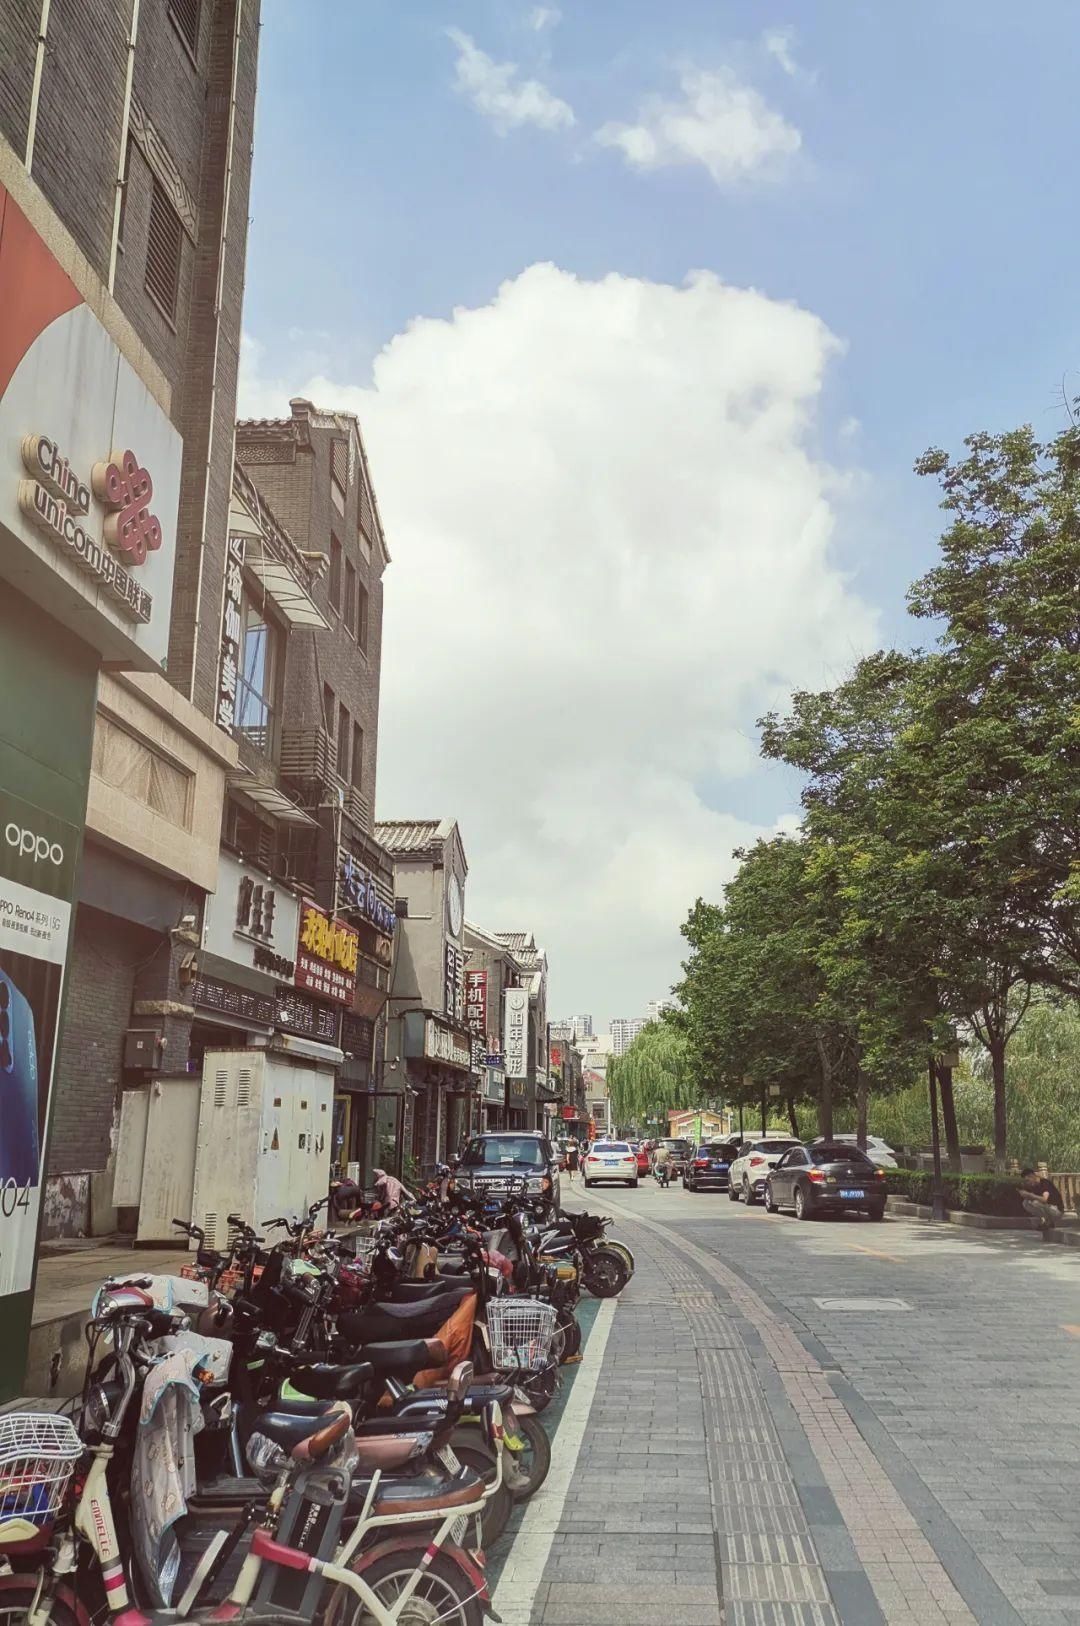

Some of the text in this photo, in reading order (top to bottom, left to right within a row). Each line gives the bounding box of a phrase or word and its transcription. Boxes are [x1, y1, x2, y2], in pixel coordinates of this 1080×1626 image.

[38, 435, 91, 515] China
[468, 973, 484, 1029] 手机配件
[91, 1499, 111, 1556] EMMELLE
